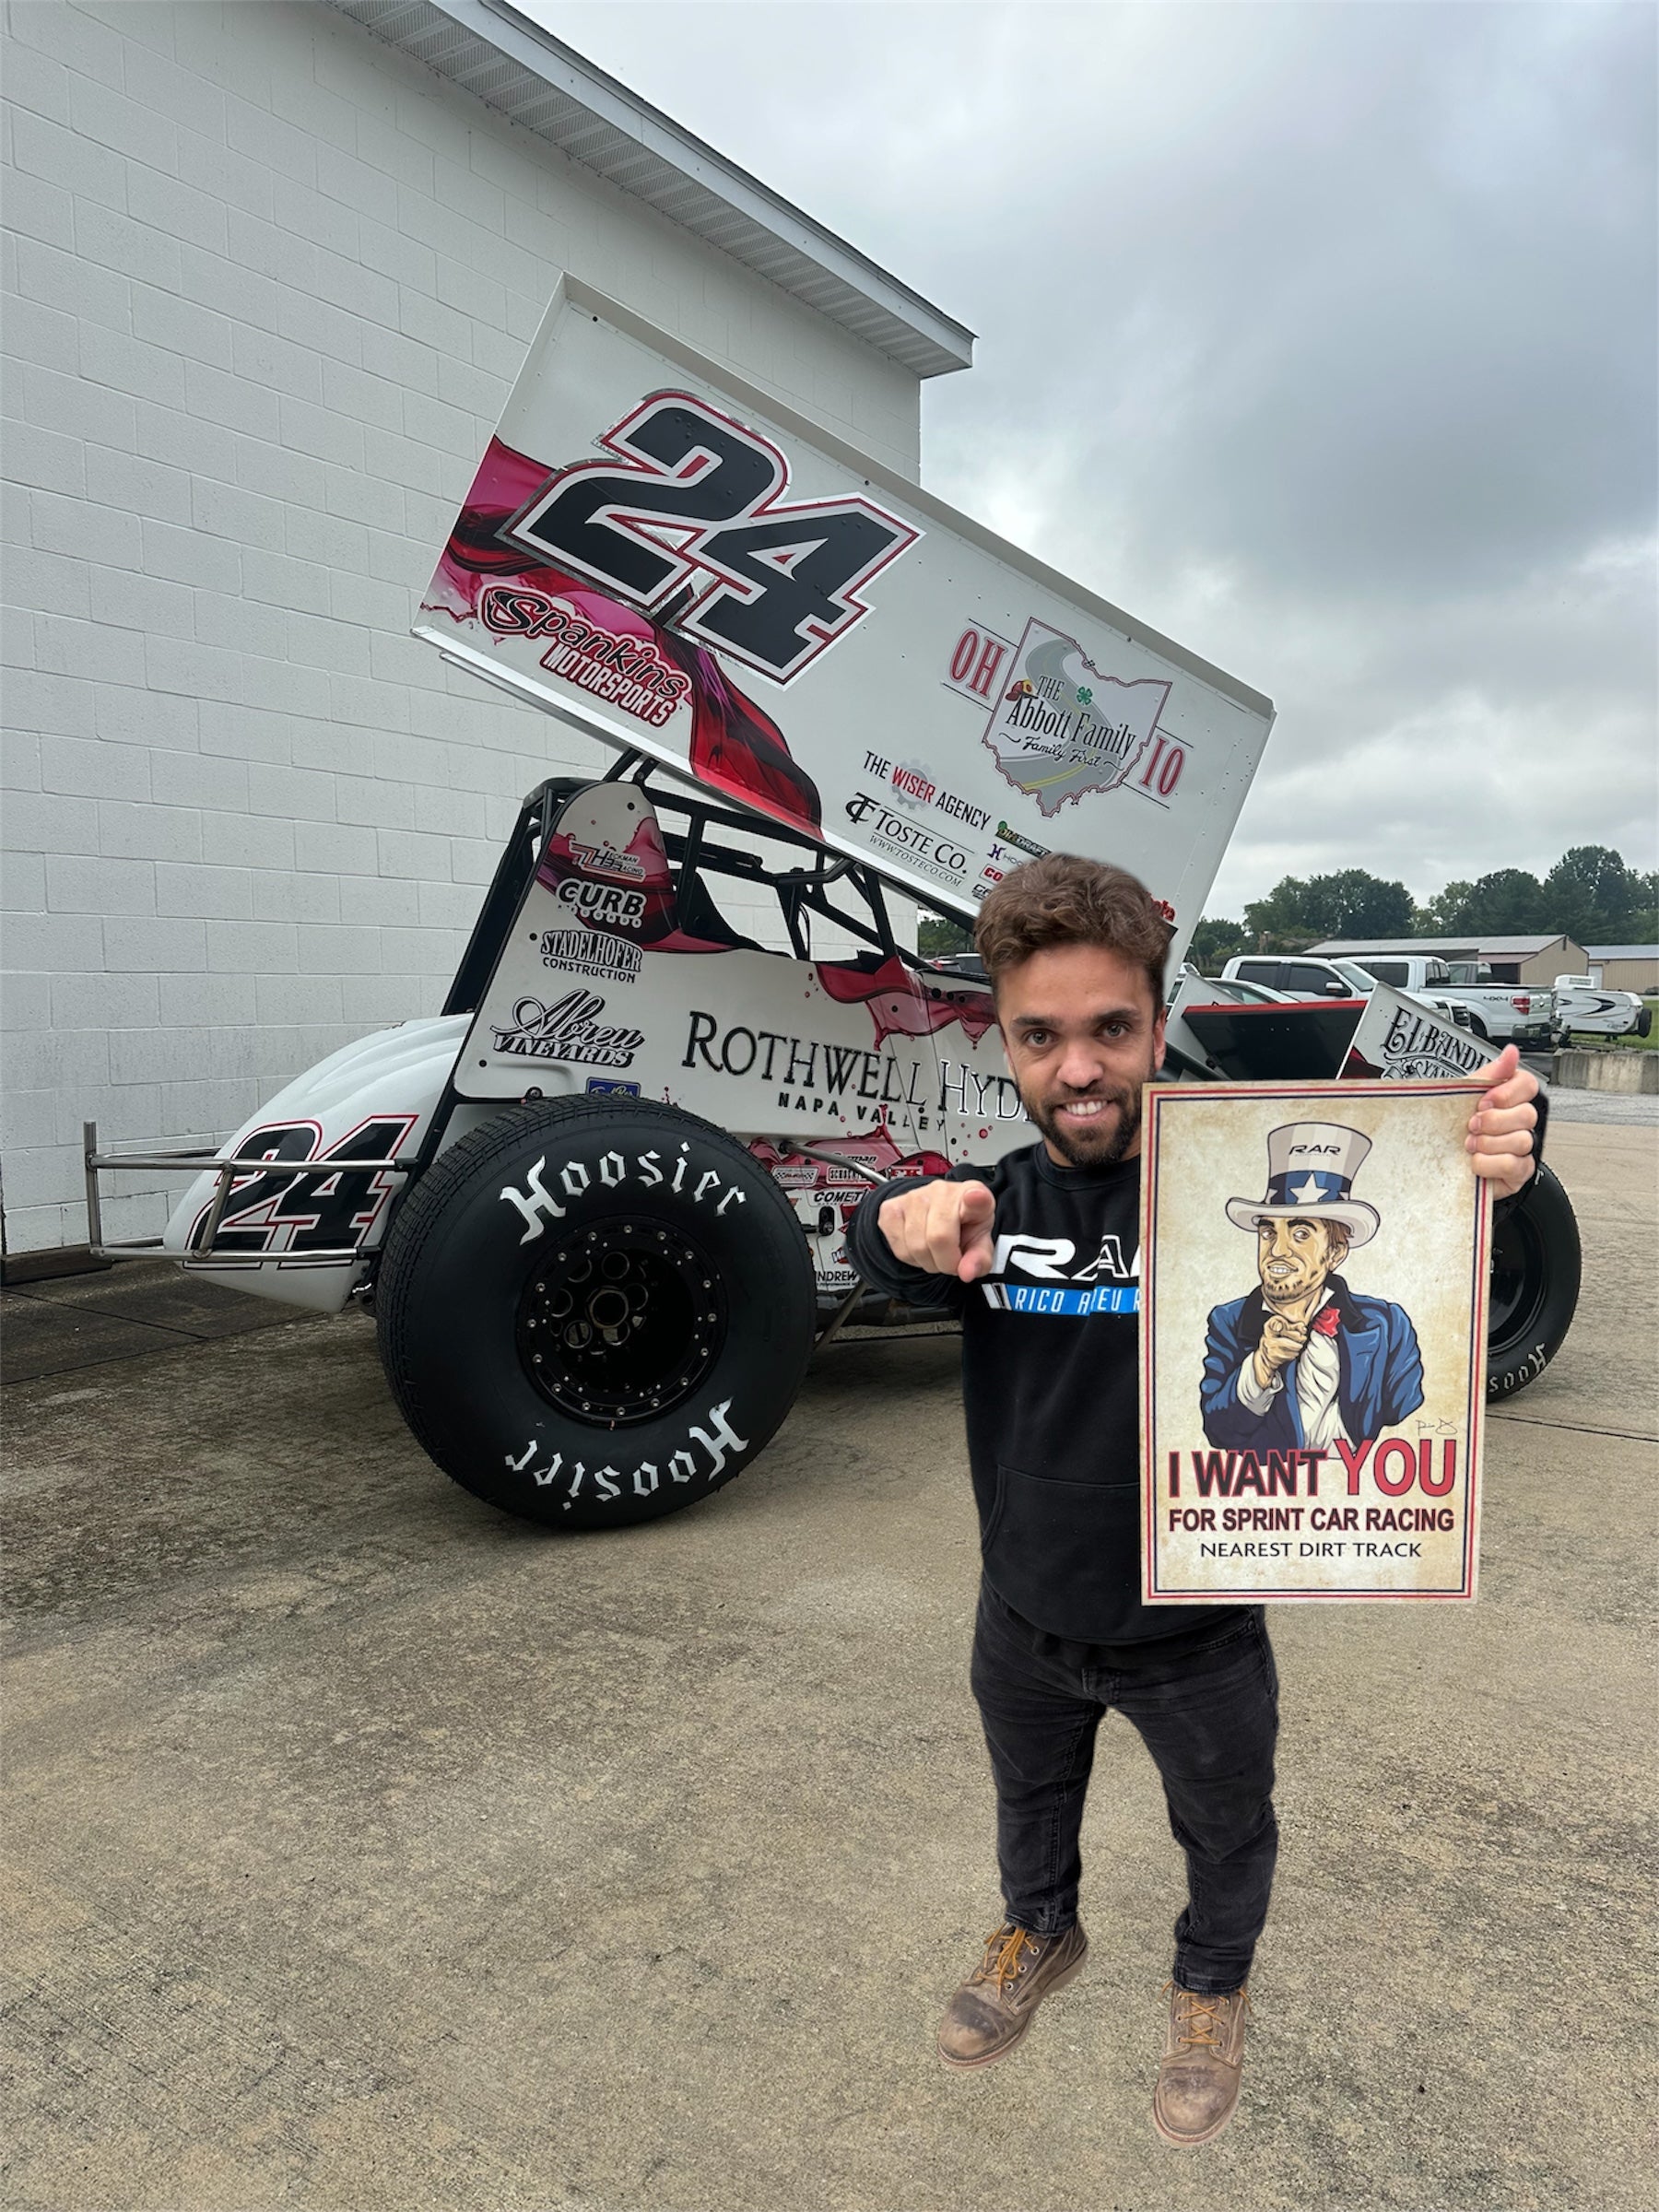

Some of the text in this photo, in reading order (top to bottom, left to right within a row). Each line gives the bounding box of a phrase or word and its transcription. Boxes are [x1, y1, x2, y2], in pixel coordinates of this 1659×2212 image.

[505, 389, 924, 688] 24
[484, 587, 689, 703] Spankins
[949, 629, 1008, 699] OH
[543, 644, 678, 726] MOTORSPORTS
[1036, 675, 1065, 701] THE
[1005, 694, 1137, 760] Abbott Family
[1022, 735, 1102, 768] Family First
[863, 750, 993, 830] THE WISER AGENCY
[870, 808, 935, 856] TOSTE
[558, 879, 647, 919] CURB
[541, 929, 643, 972] STADELHOFER
[542, 957, 636, 984] CONSTRUCTION
[493, 1034, 635, 1068] VINEYARDS
[681, 1010, 1034, 1124] ROTHWELL HYD
[779, 1091, 946, 1133] NAPA VALLEY
[1288, 1145, 1341, 1156] RAR
[183, 1114, 419, 1270] 24
[499, 1141, 747, 1247] Hoosier
[814, 1190, 864, 1203] COMET
[991, 1233, 1140, 1282] RA
[1015, 1288, 1065, 1313] RICO
[504, 1396, 749, 1511] Hoosier
[1169, 1437, 1457, 1499] I WANT YOU
[1169, 1507, 1455, 1533] FOR SPRINT CAR RACING
[1200, 1542, 1423, 1559] NEAREST DIRT TRACK
